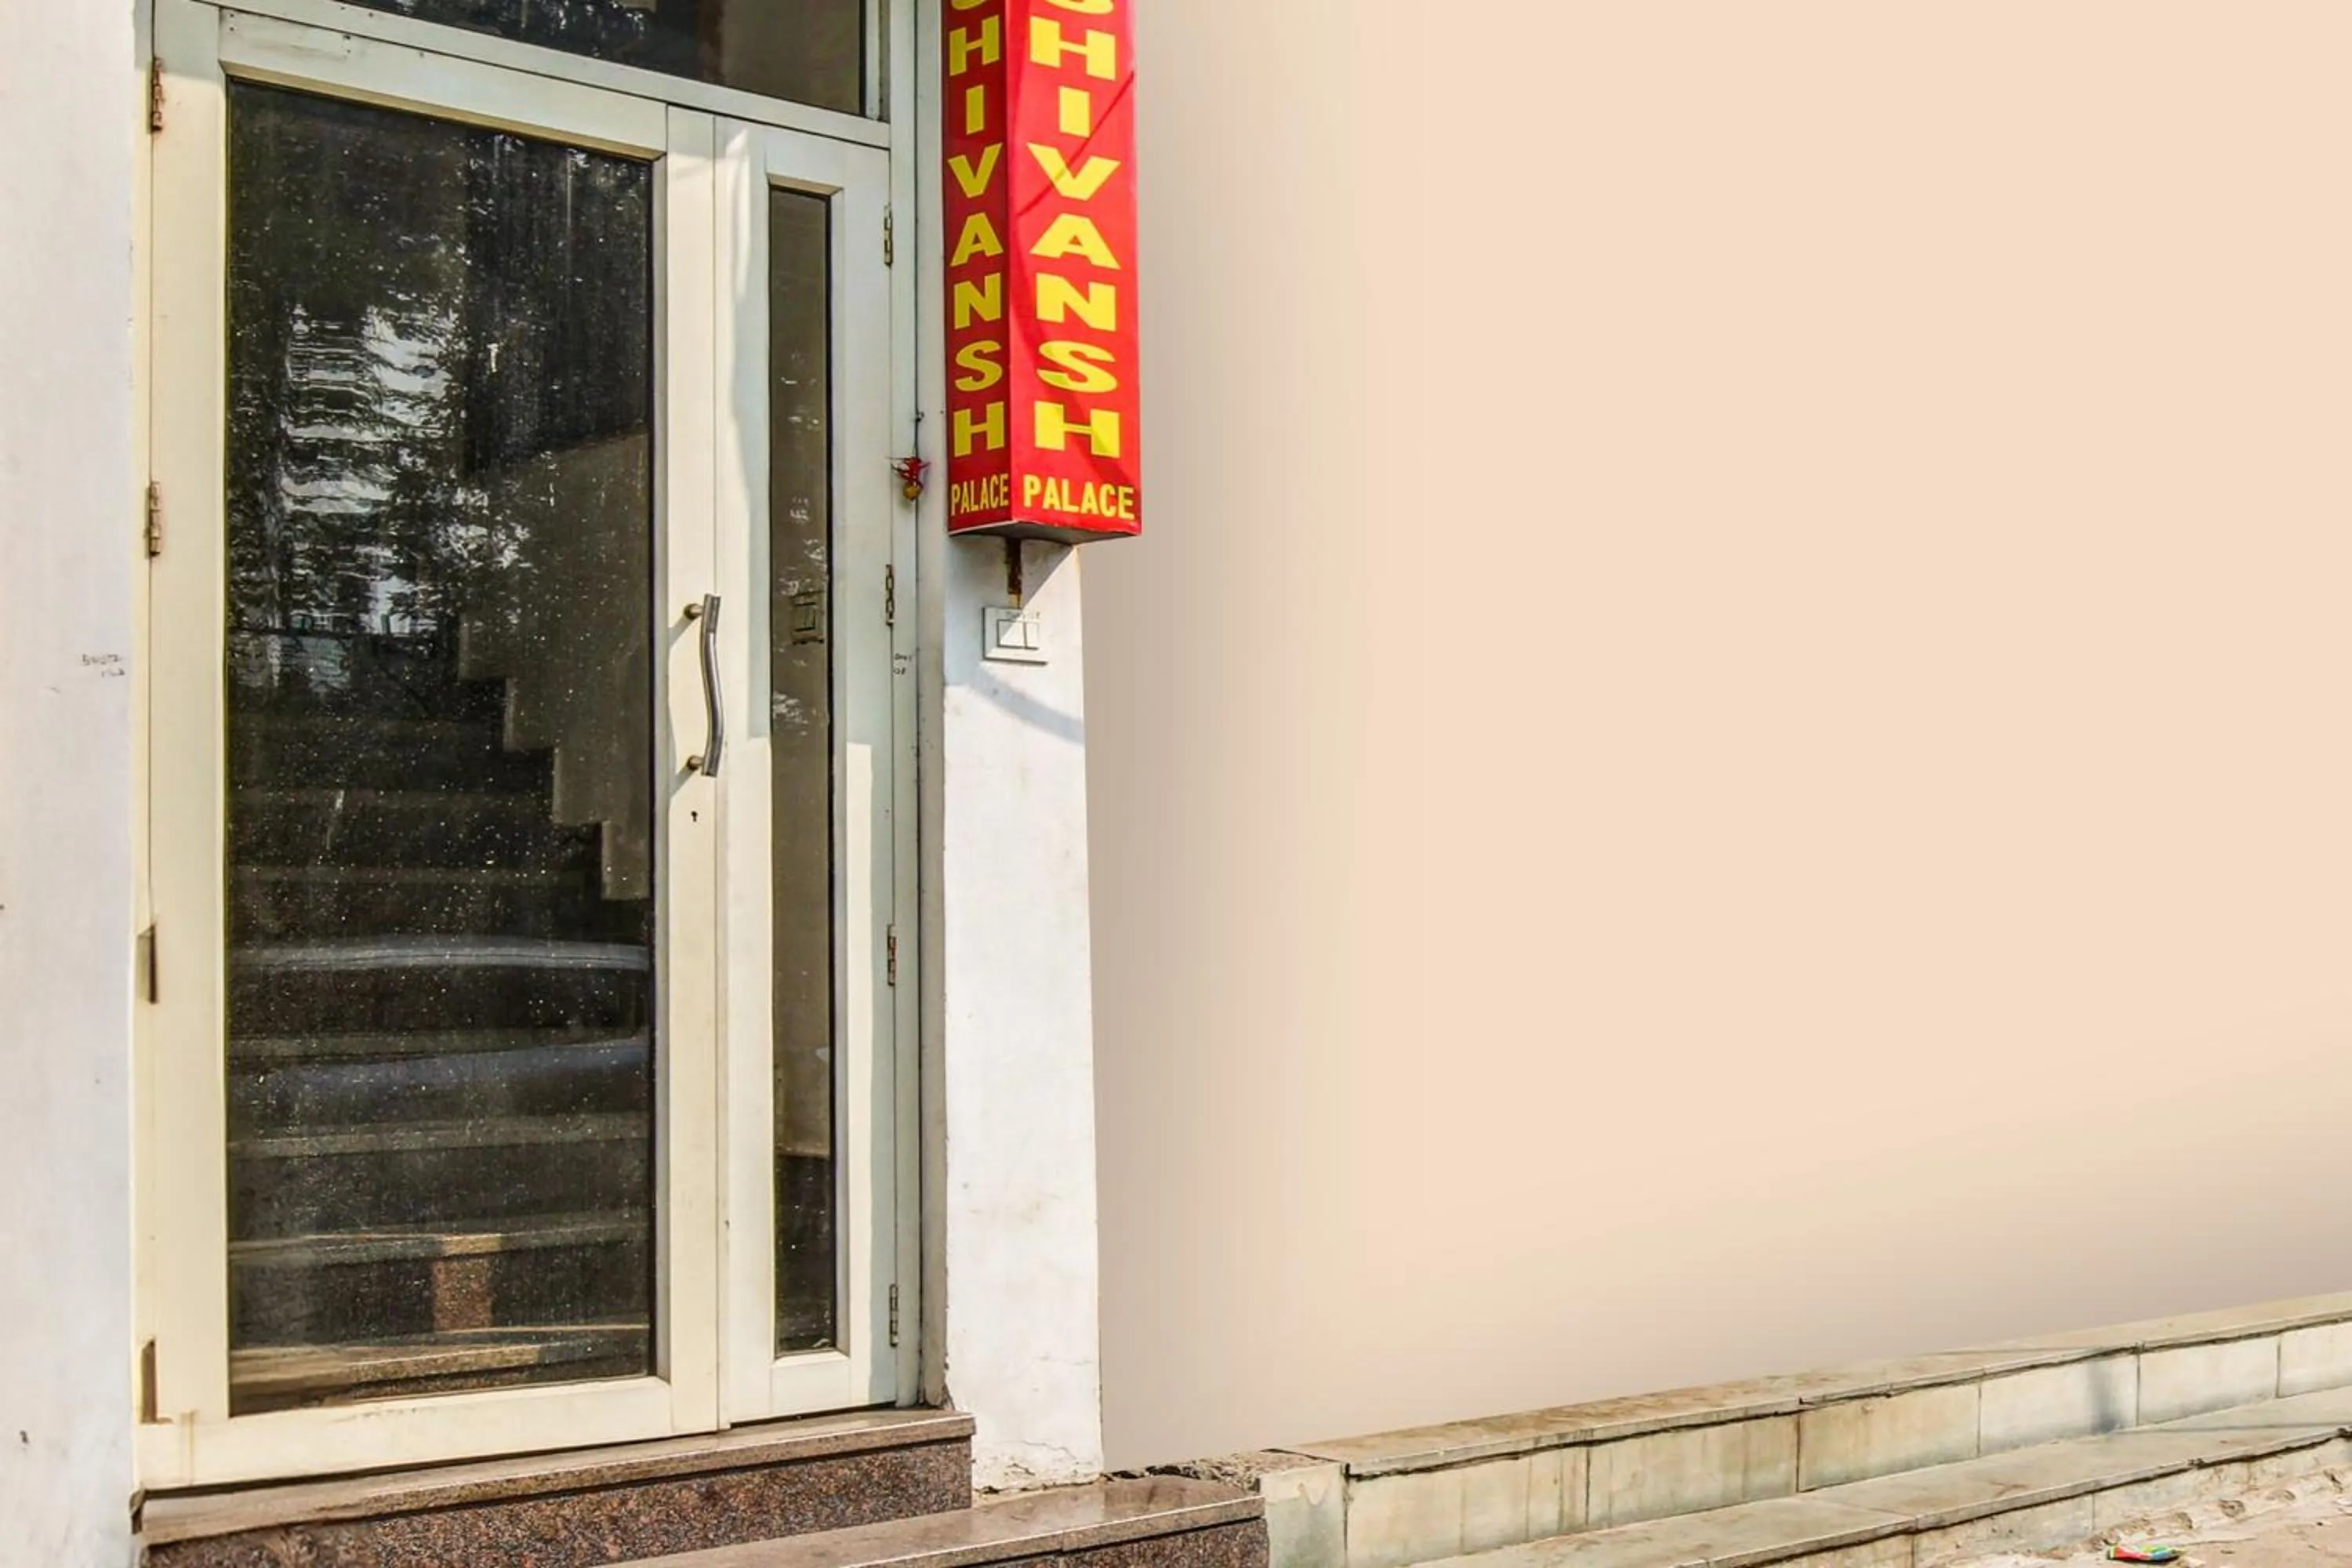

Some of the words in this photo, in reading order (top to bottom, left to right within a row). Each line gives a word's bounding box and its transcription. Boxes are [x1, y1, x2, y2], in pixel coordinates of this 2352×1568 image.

[948, 0, 1005, 457] HIVANSH
[1027, 0, 1121, 459] HIVANSH
[951, 473, 1009, 516] PALACE
[1023, 474, 1135, 520] PALACE
